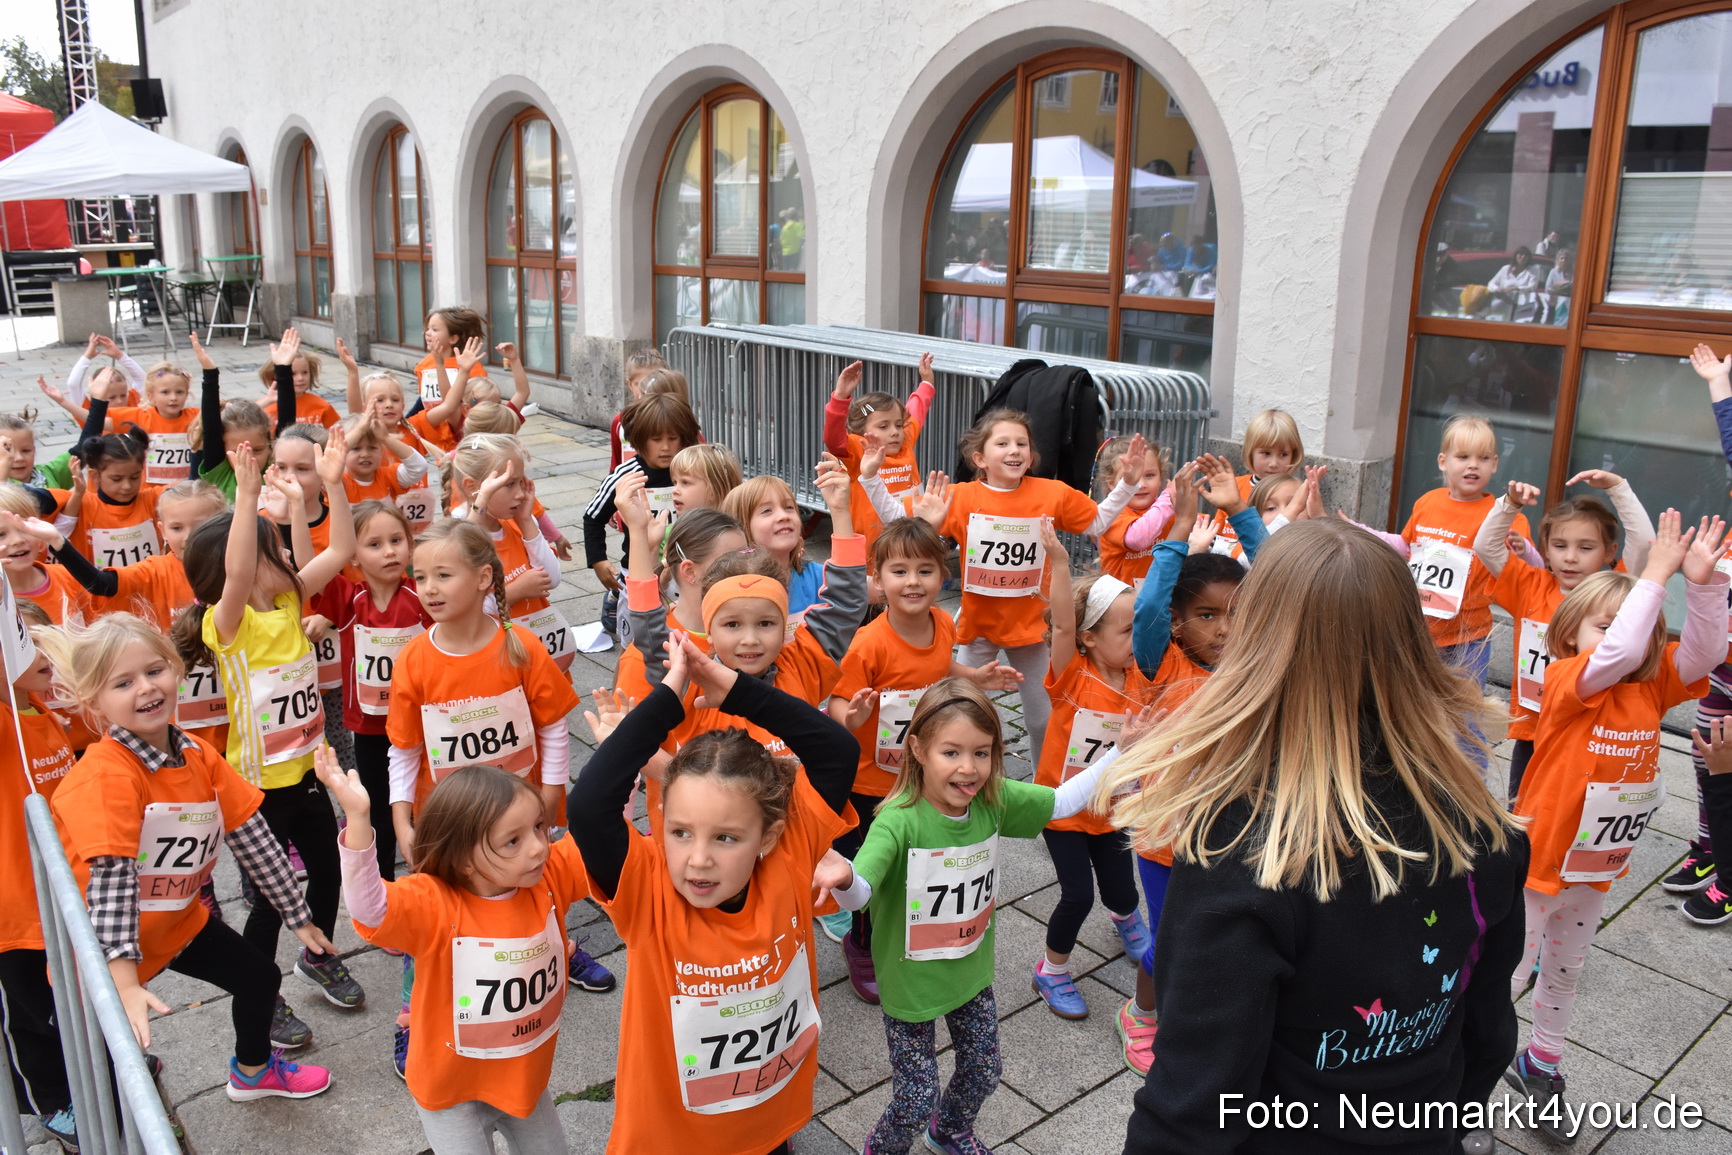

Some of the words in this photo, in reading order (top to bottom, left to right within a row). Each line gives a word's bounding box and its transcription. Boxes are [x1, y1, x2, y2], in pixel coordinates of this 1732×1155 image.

[425, 384, 442, 399] 715
[155, 449, 192, 464] 7270
[400, 504, 426, 520] 32
[1001, 524, 1030, 533] BOCK
[103, 542, 153, 567] 7113
[980, 540, 1037, 566] 7394
[539, 628, 566, 655] 37
[365, 655, 393, 682] 70
[1528, 649, 1550, 675] 71
[189, 672, 218, 697] 71
[210, 701, 226, 711] Lau
[271, 682, 319, 725] 705
[461, 706, 498, 721] BOCK
[441, 721, 519, 762] 7084
[1084, 738, 1115, 763] 71
[191, 811, 217, 822] BOC
[153, 826, 221, 868] 7214
[957, 849, 990, 867] BOCK
[1607, 852, 1629, 865] Frid
[927, 868, 994, 917] 7179
[959, 926, 976, 938] Lea
[510, 938, 550, 961] BOCK
[476, 955, 558, 1016] 7003
[737, 985, 785, 1014] BOCK
[512, 1018, 542, 1037] Julia
[1367, 999, 1436, 1038] Magic
[701, 999, 800, 1070] 7272
[732, 1054, 794, 1096] LEA
